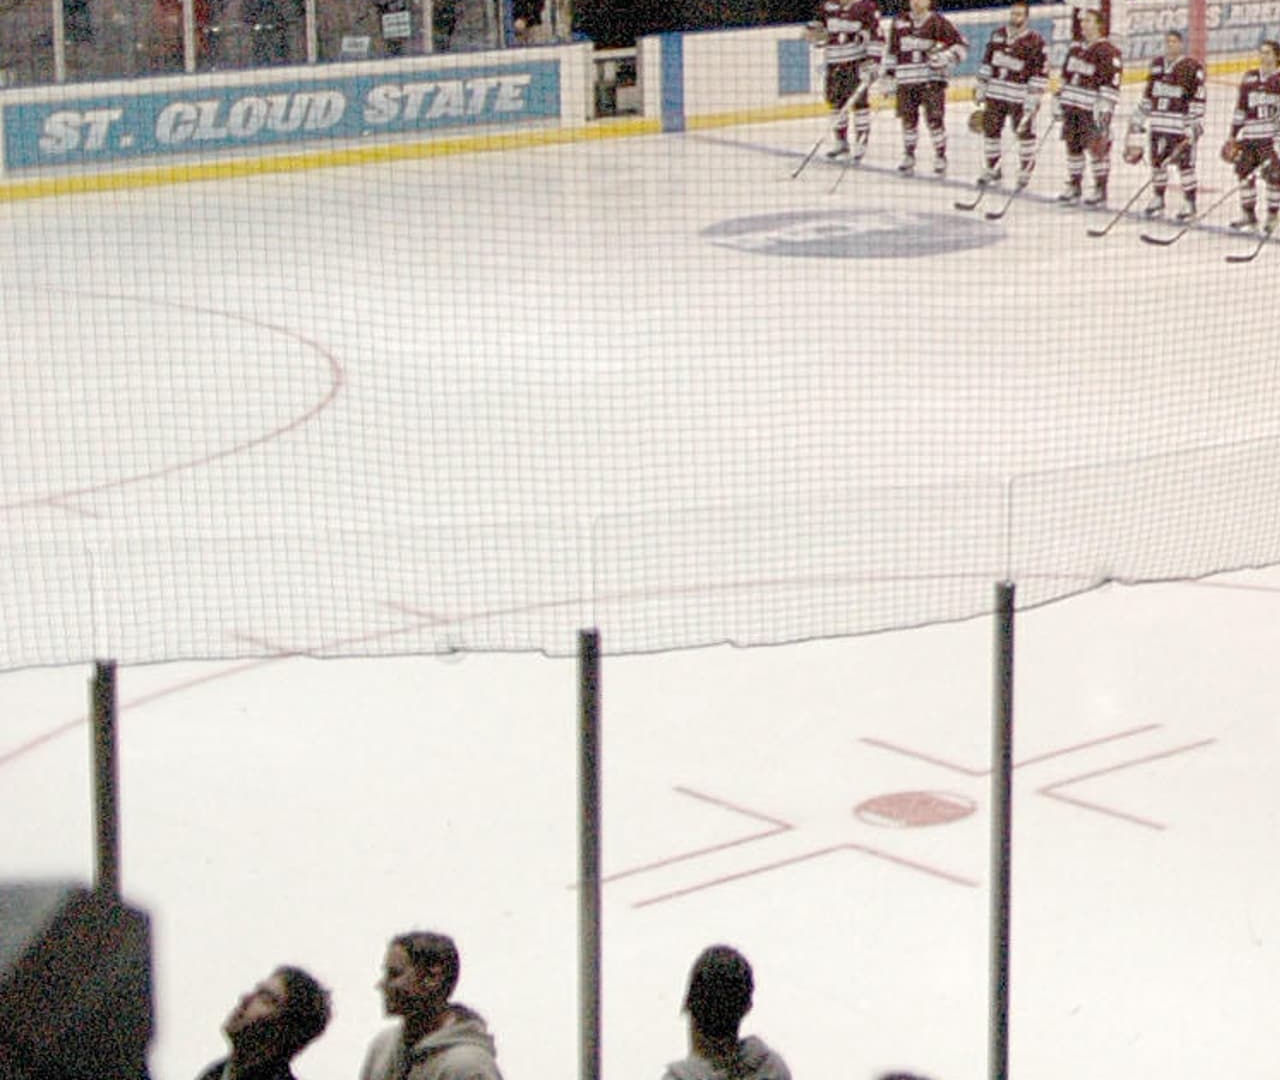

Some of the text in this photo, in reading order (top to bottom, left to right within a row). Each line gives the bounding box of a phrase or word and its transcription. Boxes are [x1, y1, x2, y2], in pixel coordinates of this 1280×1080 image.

[38, 73, 533, 154] ST. CLOUD STATE
